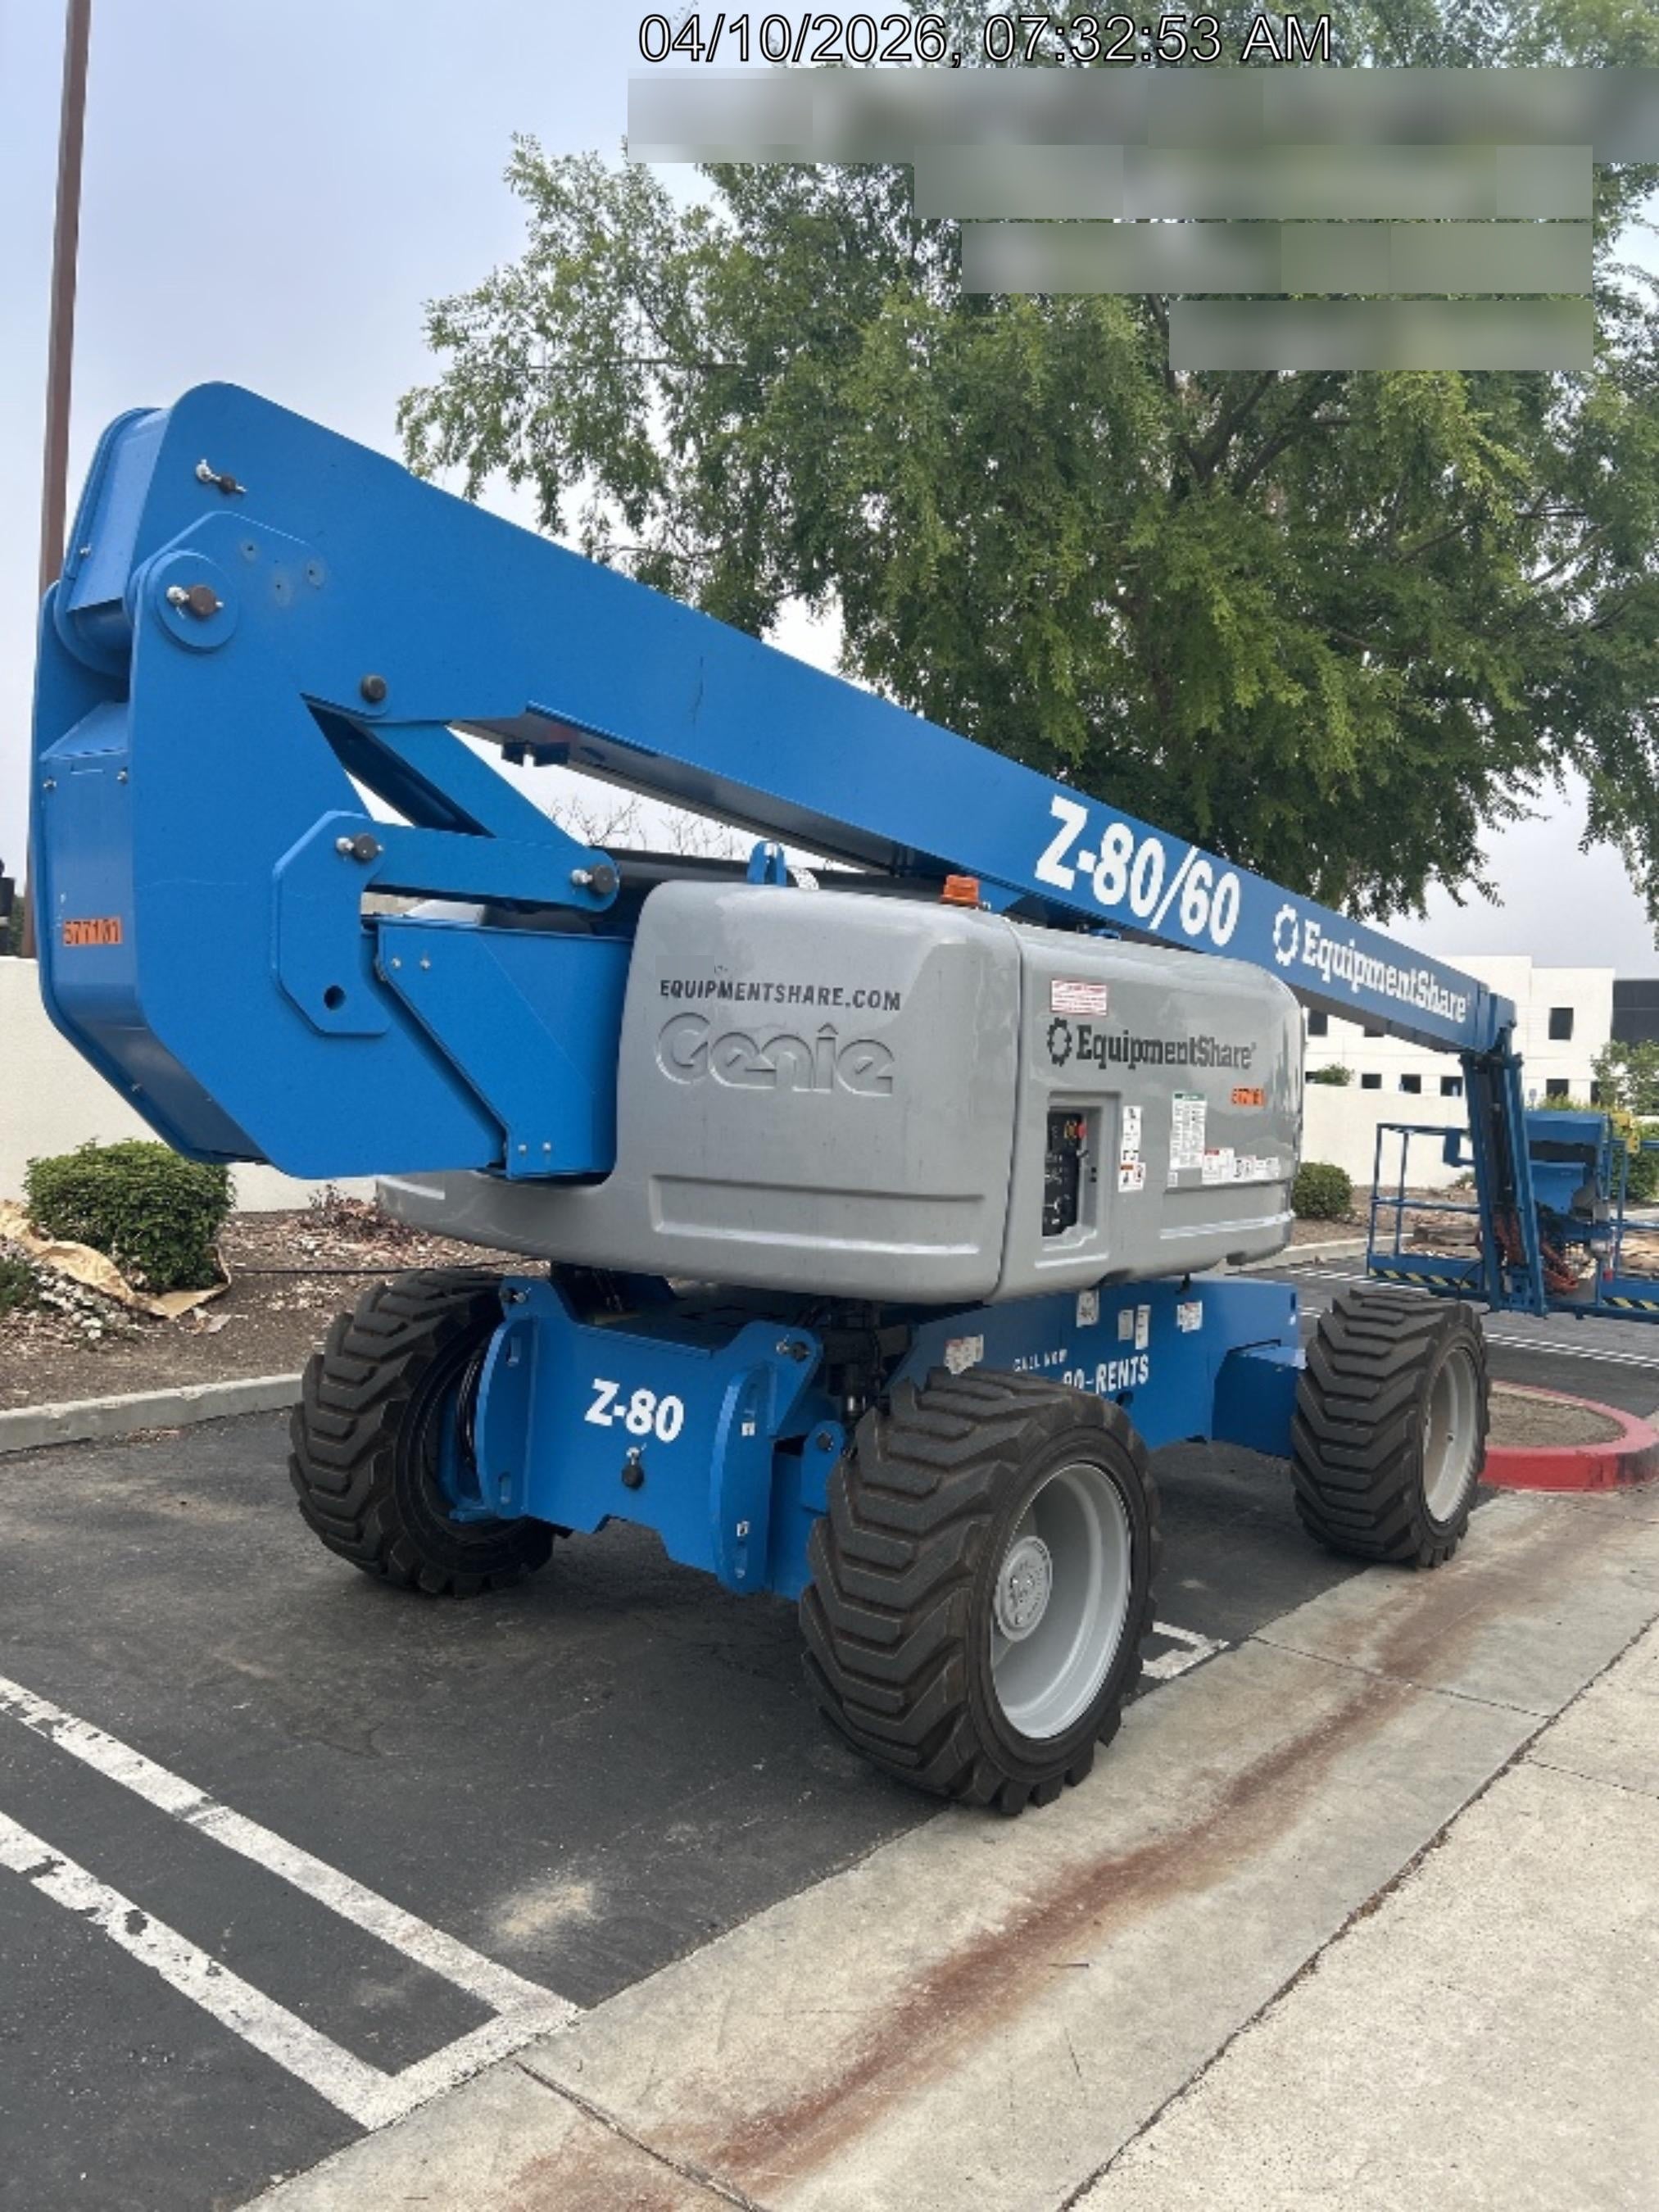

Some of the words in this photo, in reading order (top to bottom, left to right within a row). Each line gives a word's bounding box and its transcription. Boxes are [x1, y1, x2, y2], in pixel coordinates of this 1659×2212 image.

[1034, 795, 1241, 948] Z-80/60
[659, 979, 900, 1011] EQUIPMENTSHARE.COM
[1301, 919, 1467, 1023] EquipmentShare
[655, 1012, 895, 1097] Genie
[1076, 1025, 1253, 1070] EquipmentShare
[584, 1378, 684, 1443] Z-80
